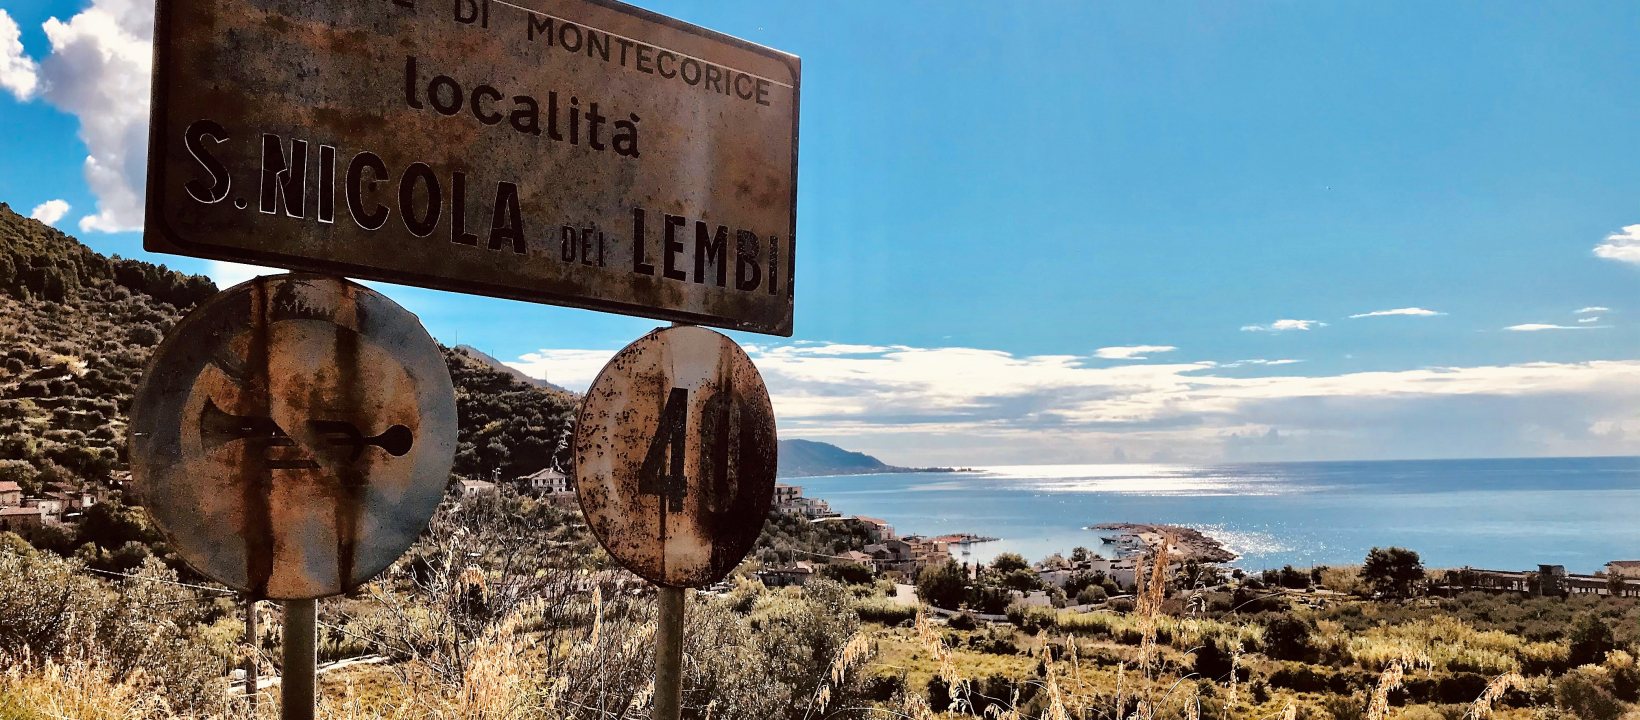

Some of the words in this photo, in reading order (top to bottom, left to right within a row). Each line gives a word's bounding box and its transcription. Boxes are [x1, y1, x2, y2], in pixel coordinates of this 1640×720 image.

[453, 0, 489, 28] DI
[526, 11, 772, 106] MONTECORICE
[404, 55, 641, 159] località
[560, 226, 604, 268] DEI
[633, 207, 779, 296] LEMBI
[637, 386, 742, 514] 40
